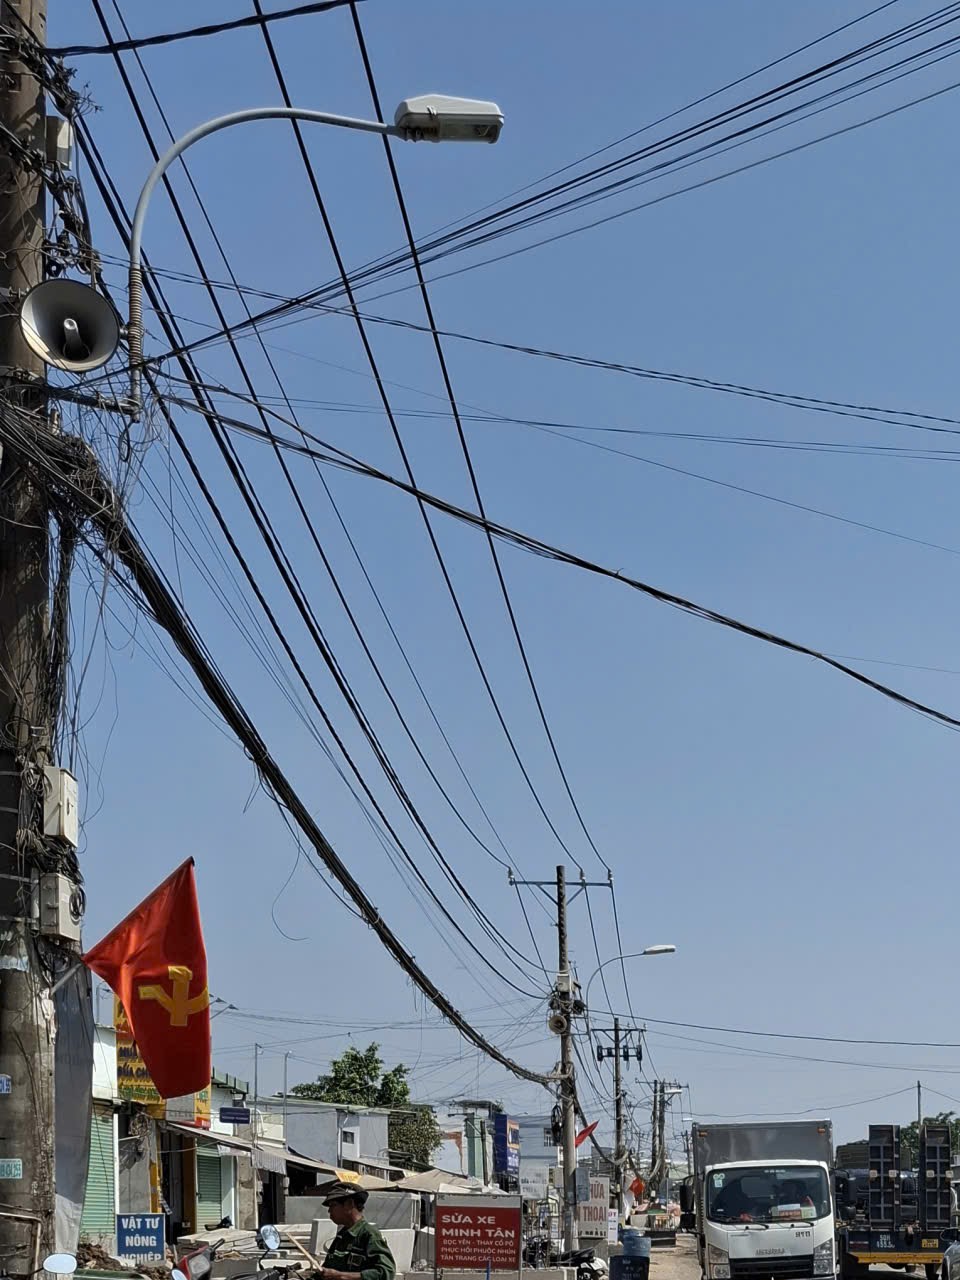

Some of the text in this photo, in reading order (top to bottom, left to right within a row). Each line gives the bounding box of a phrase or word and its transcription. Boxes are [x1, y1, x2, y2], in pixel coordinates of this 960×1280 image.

[121, 1216, 160, 1231] VẬT TƯ
[441, 1212, 496, 1224] SỬA XE
[441, 1227, 515, 1238] MINH TÂN
[125, 1234, 157, 1247] NÔNG
